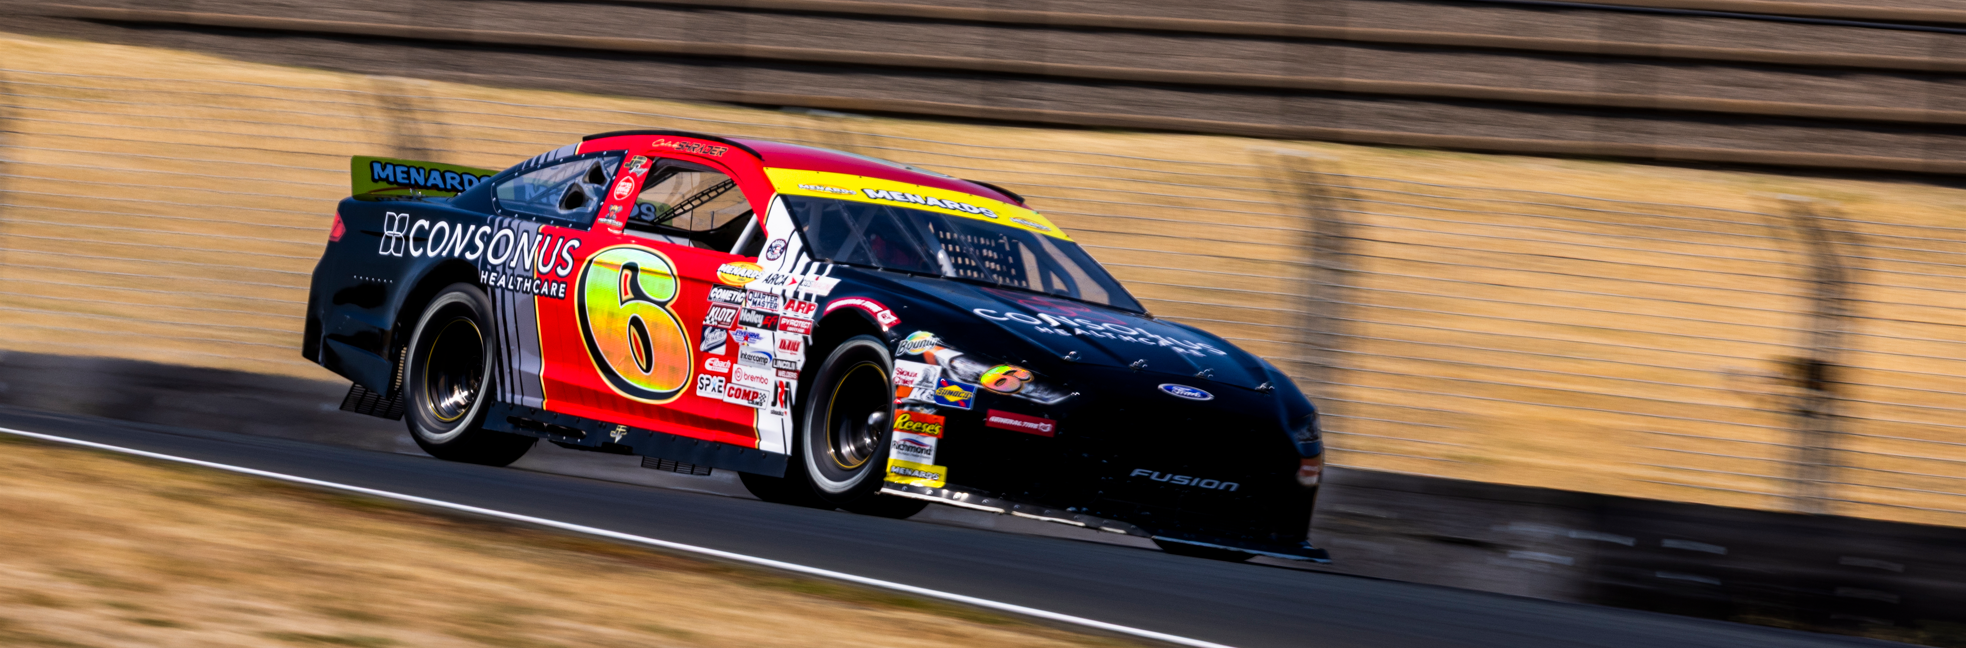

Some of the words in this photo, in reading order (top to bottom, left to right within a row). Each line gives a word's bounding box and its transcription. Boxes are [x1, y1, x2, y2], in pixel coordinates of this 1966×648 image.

[675, 141, 729, 157] SHRADER
[861, 188, 998, 218] MENARDS
[408, 219, 582, 278] CONSONUS
[716, 263, 765, 280] MENARDS
[762, 272, 789, 287] ARCA
[480, 270, 568, 298] HEALTHCARE
[710, 287, 746, 303] COMETIC
[751, 299, 778, 310] MASTER
[784, 299, 817, 314] ARP
[708, 306, 736, 323] KLOTZ
[740, 309, 764, 327] Holley
[574, 244, 694, 404] 6
[973, 308, 1227, 355] CONSONUS
[1035, 326, 1206, 357] HEALTHCARE
[743, 373, 769, 385] brembo
[978, 363, 1034, 395] 6
[727, 386, 759, 401] COMP
[938, 388, 971, 399] SUNOCO
[747, 399, 763, 407] CAMS
[892, 440, 932, 456] Richmond
[891, 466, 939, 480] MENARDS
[1129, 468, 1241, 492] FUSION
